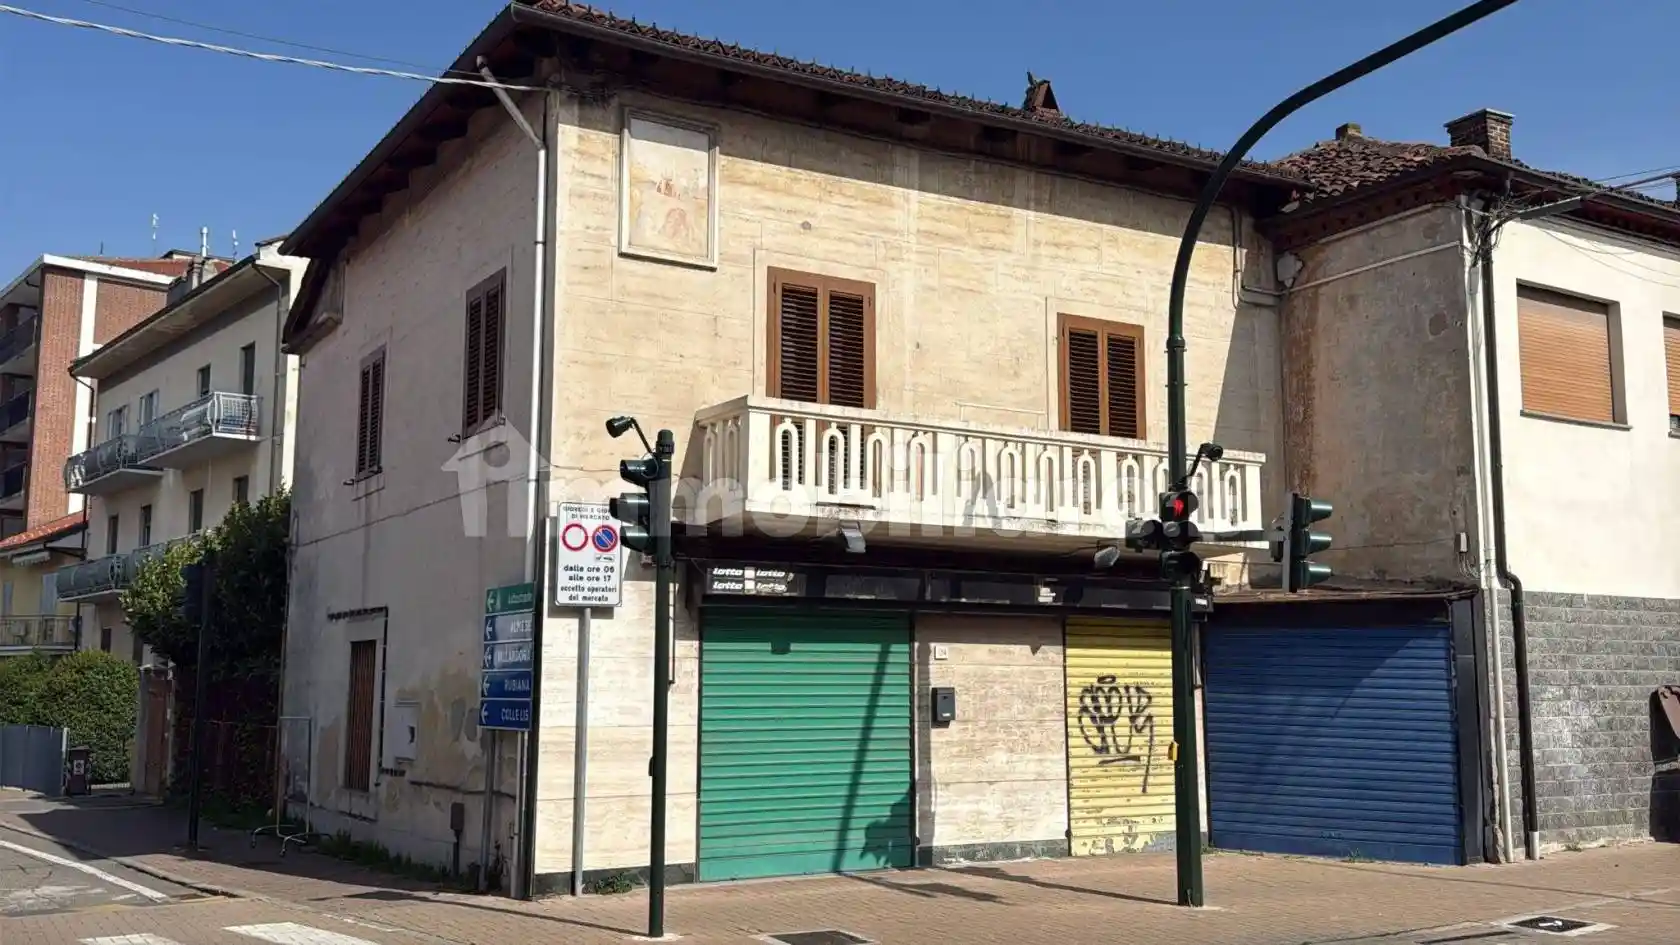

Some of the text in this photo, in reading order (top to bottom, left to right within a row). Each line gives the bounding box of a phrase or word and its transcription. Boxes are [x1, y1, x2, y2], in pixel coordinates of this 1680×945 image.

[563, 564, 584, 572] dalle
[568, 573, 584, 581] alle
[603, 574, 611, 582] 17
[560, 584, 617, 594] eccetto operatori
[504, 679, 531, 692] RUBIANA
